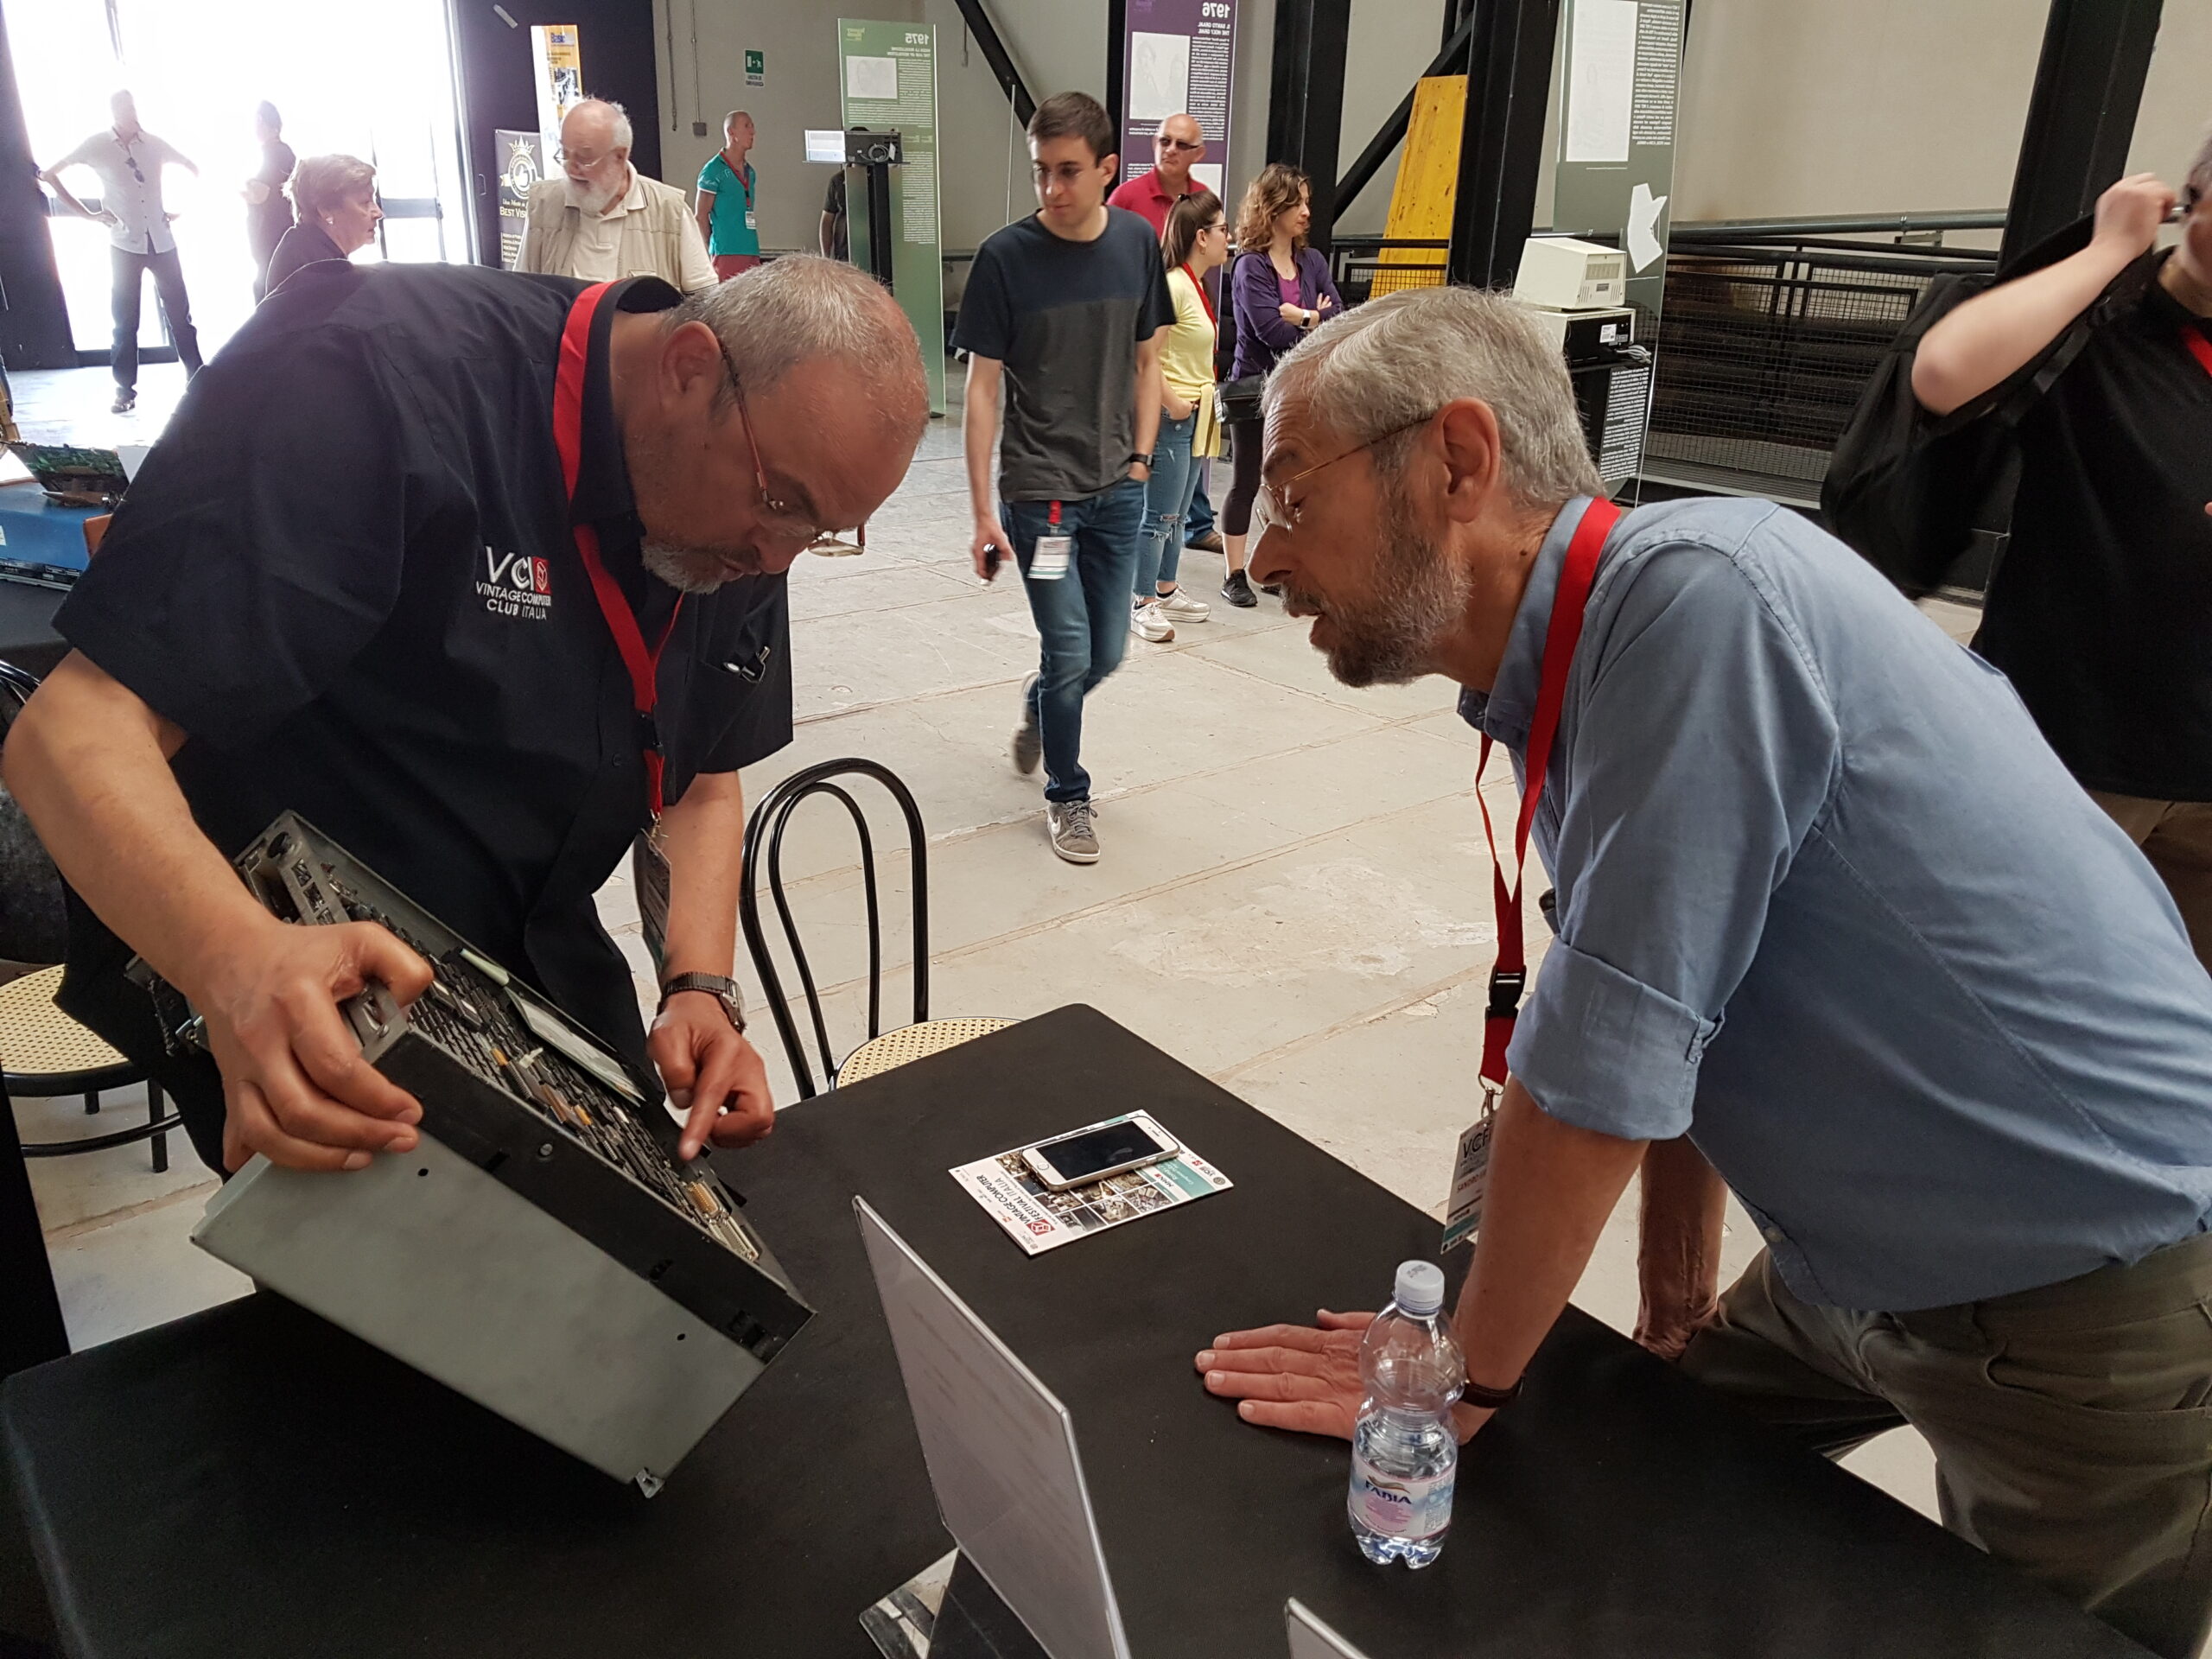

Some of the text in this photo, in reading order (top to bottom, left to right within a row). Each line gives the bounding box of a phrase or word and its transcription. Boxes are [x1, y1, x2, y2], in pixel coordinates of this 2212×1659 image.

[499, 206, 515, 217] BEST
[486, 598, 519, 616] CLUB
[976, 1174, 1007, 1203] COMPUTER
[995, 1177, 1017, 1197] ITALIA
[1003, 1202, 1031, 1224] VINTAGE
[1014, 1196, 1043, 1221] FESTIVAL
